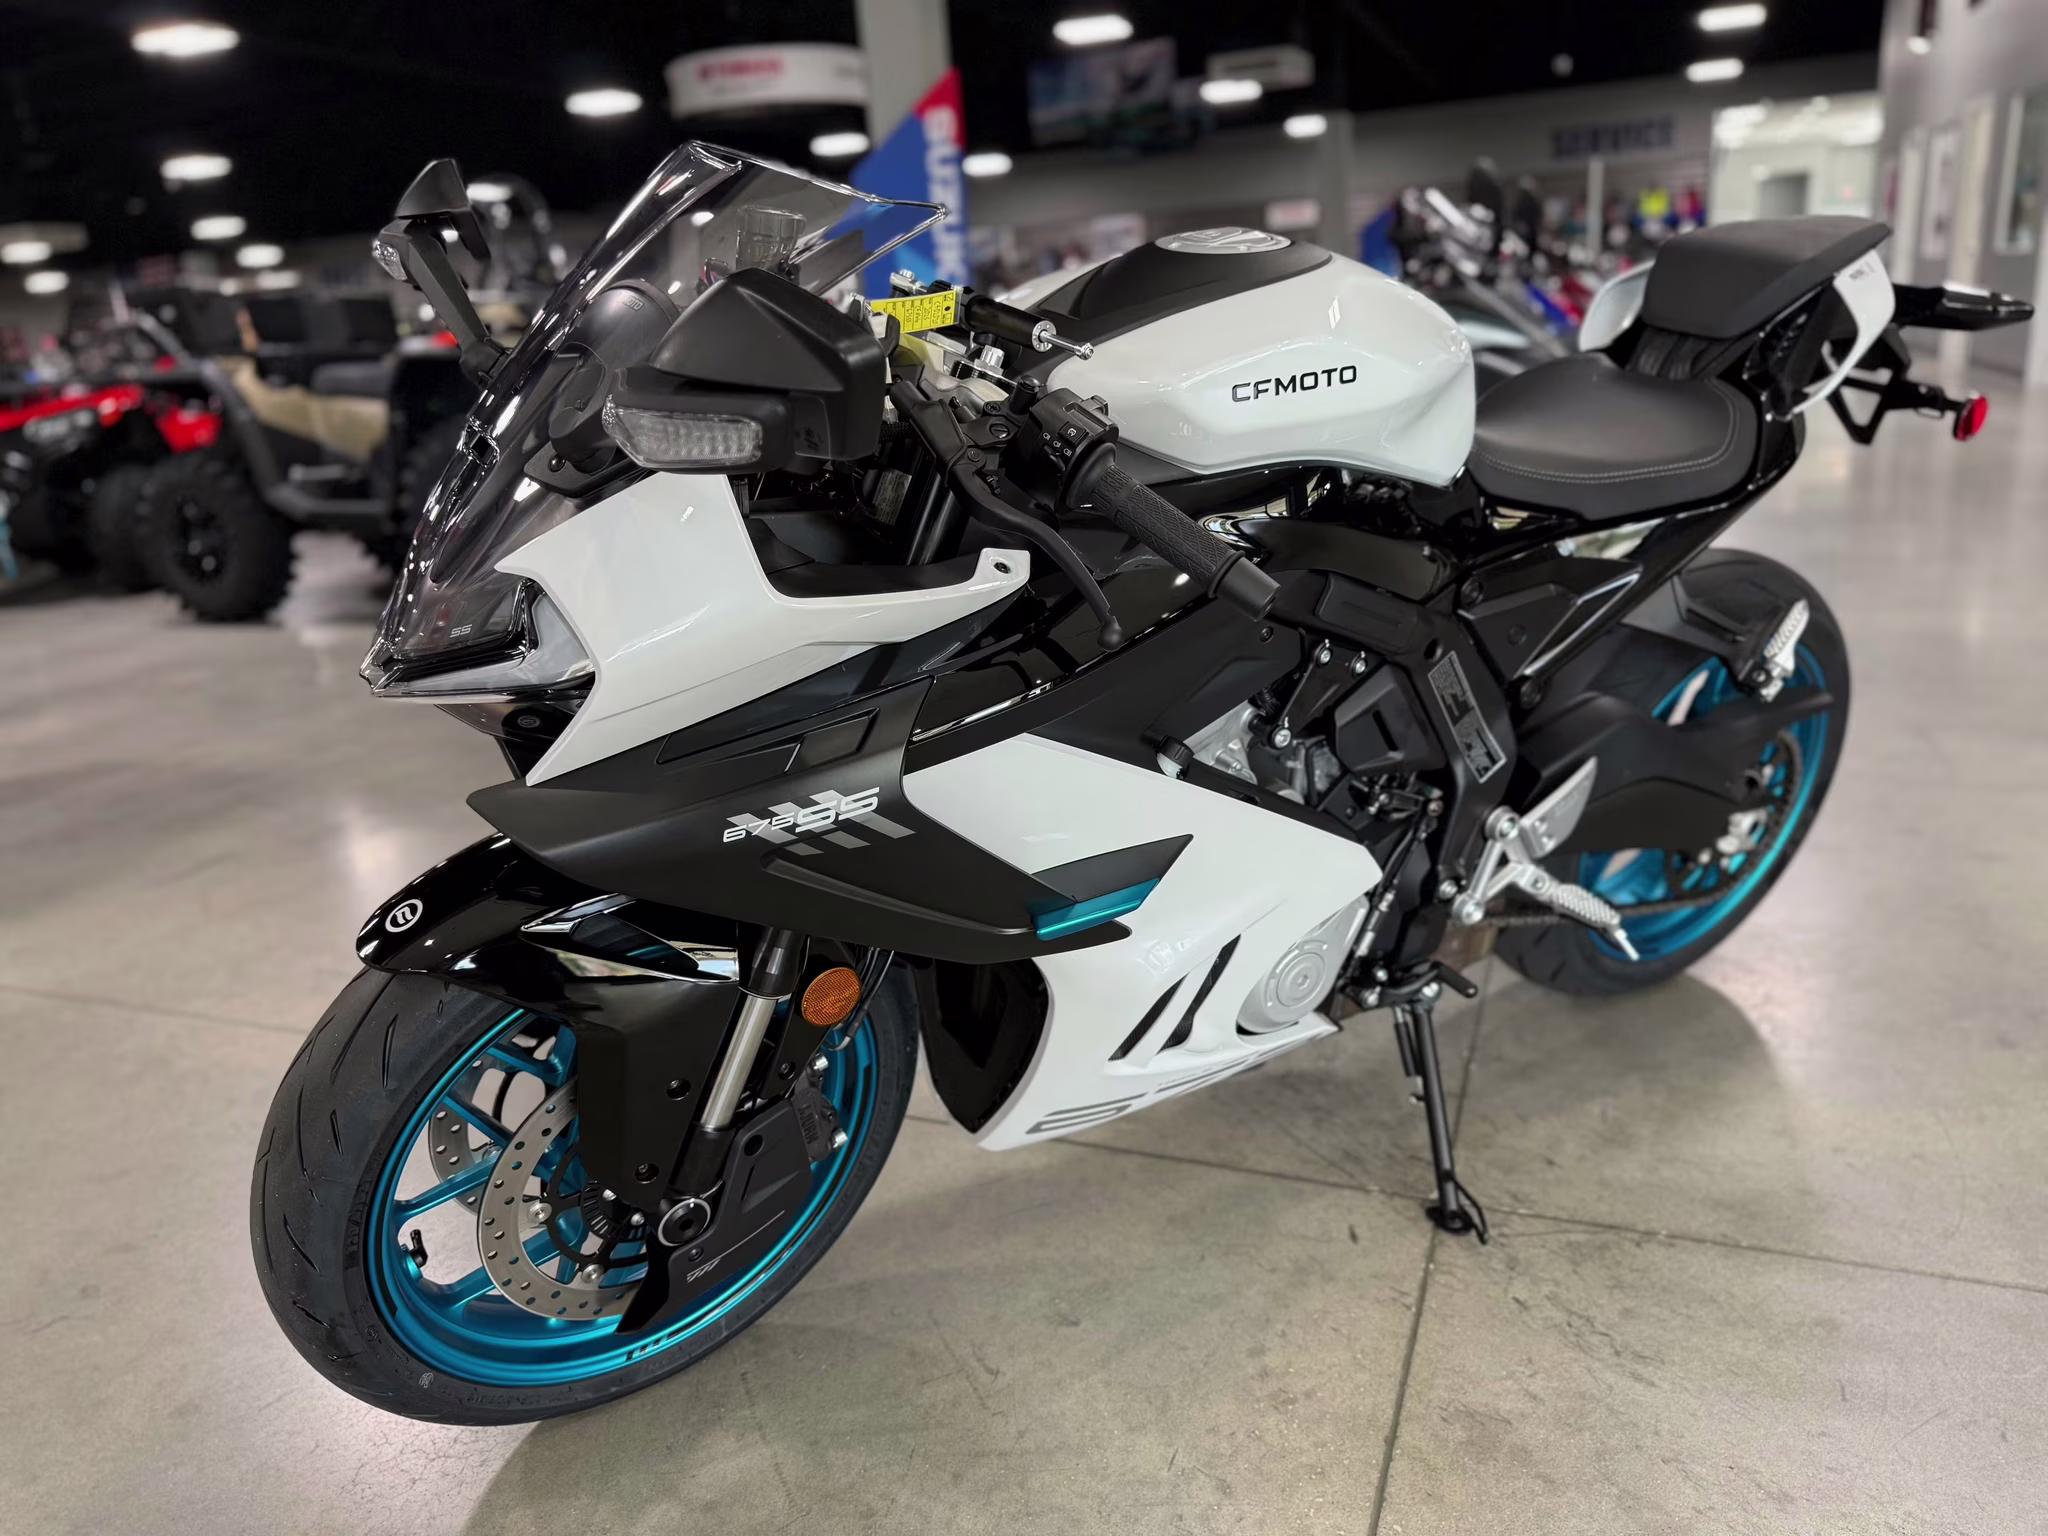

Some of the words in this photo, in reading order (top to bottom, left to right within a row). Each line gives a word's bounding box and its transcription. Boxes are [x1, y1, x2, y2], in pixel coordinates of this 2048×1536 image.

[922, 105, 968, 286] SUZUK
[1231, 365, 1357, 403] CFMOTO
[449, 623, 473, 638] SS
[722, 786, 880, 843] 675SS
